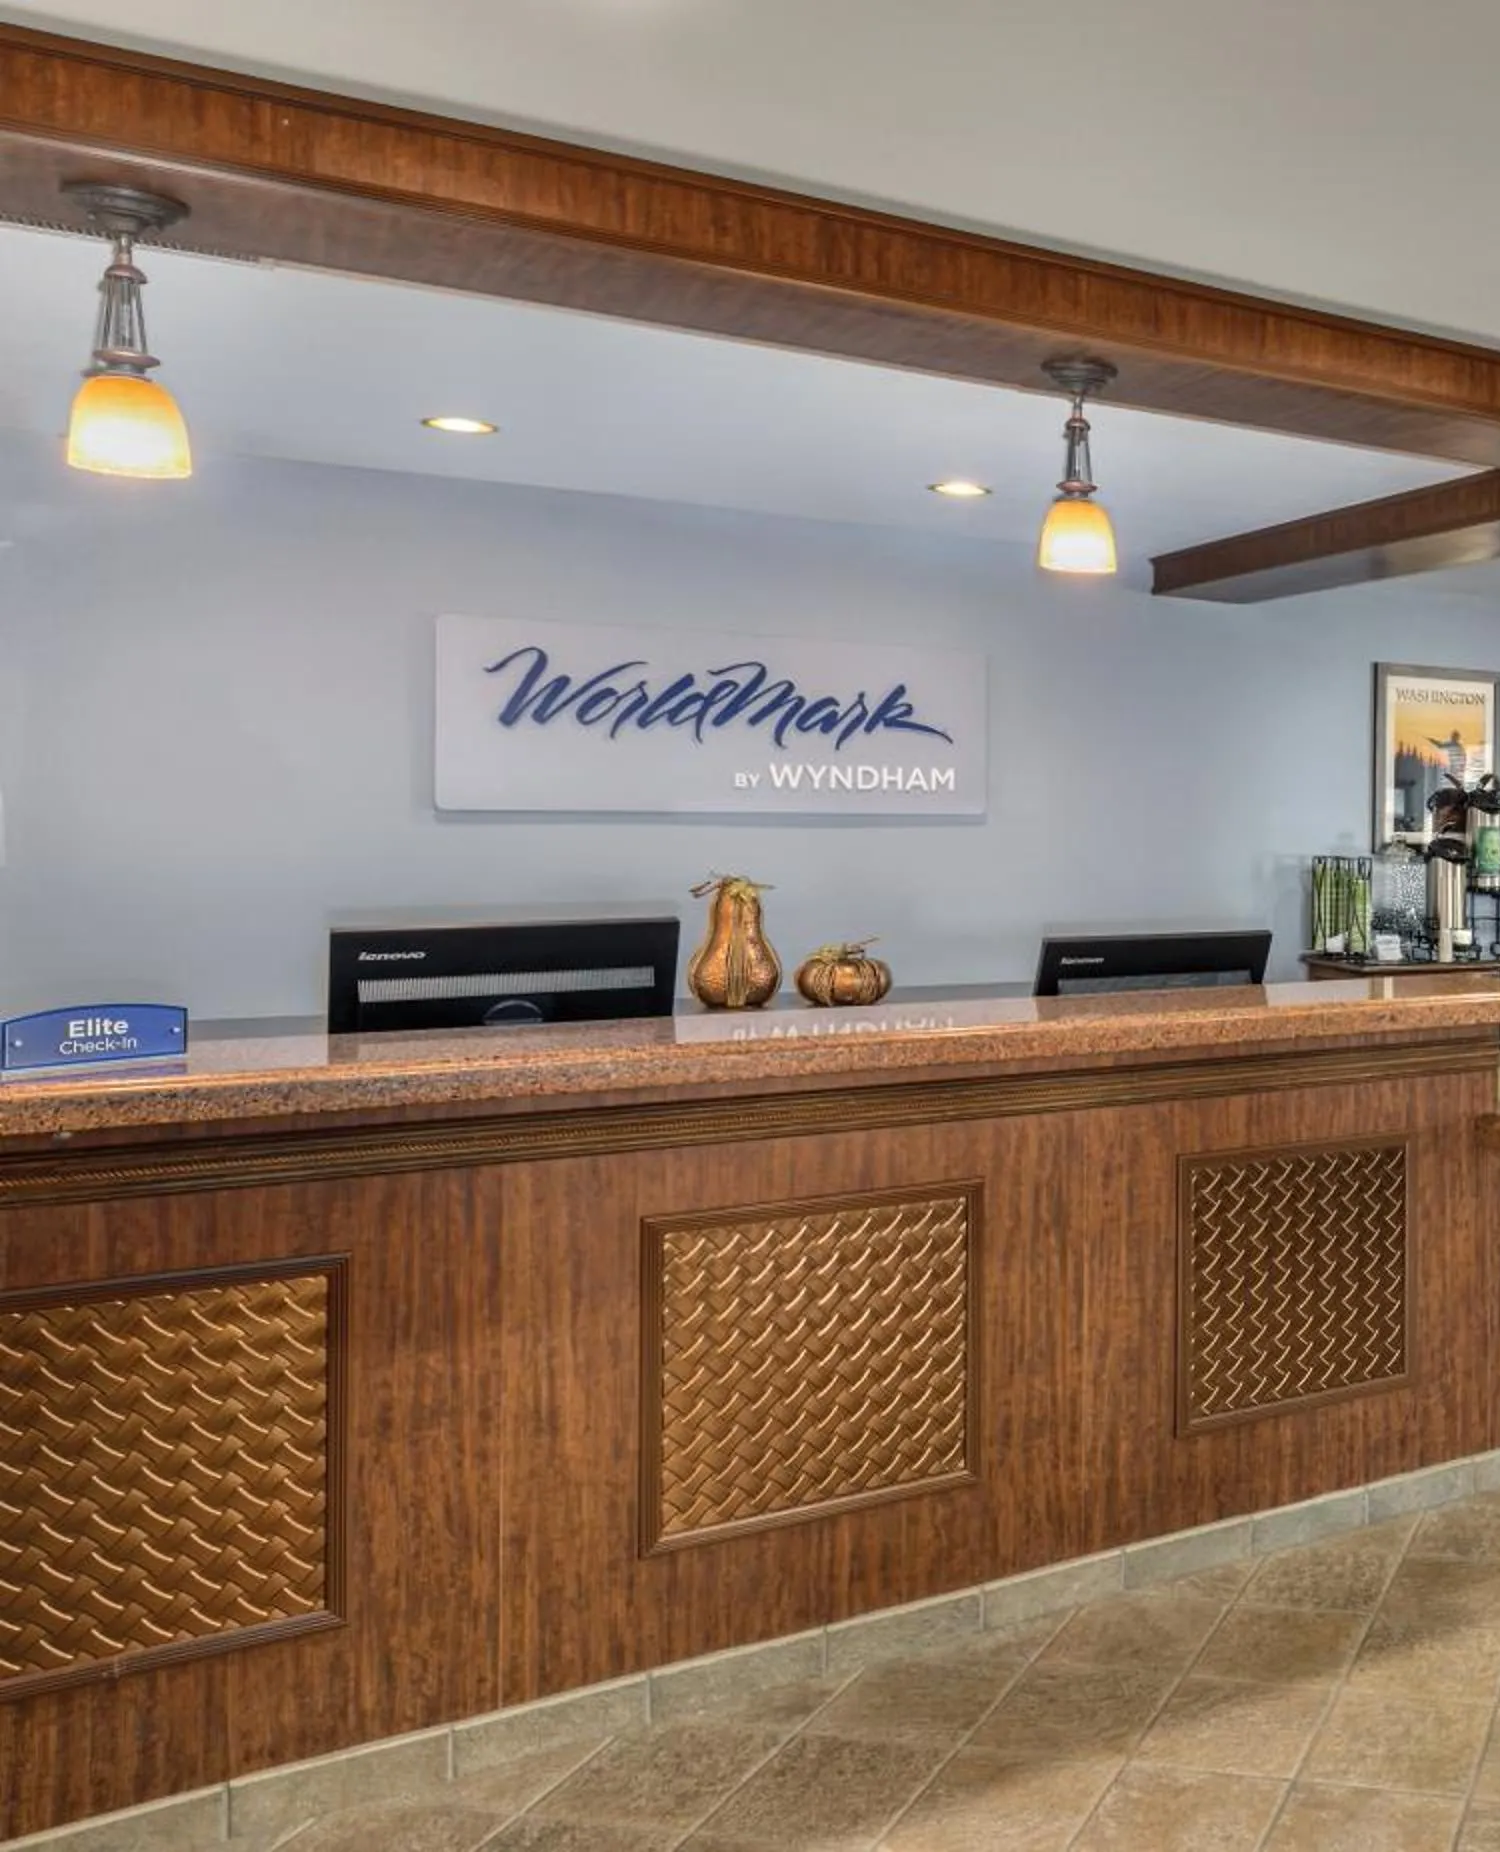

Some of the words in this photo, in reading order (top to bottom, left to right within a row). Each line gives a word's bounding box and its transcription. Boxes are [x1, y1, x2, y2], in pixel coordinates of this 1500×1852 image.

[483, 646, 954, 751] WorldMark
[1396, 688, 1485, 704] WASHINGTON
[734, 772, 760, 788] BY
[769, 763, 956, 791] WYNDHAM
[358, 951, 426, 961] lenovo
[68, 1018, 129, 1038] Elite
[59, 1036, 137, 1055] Check-In
